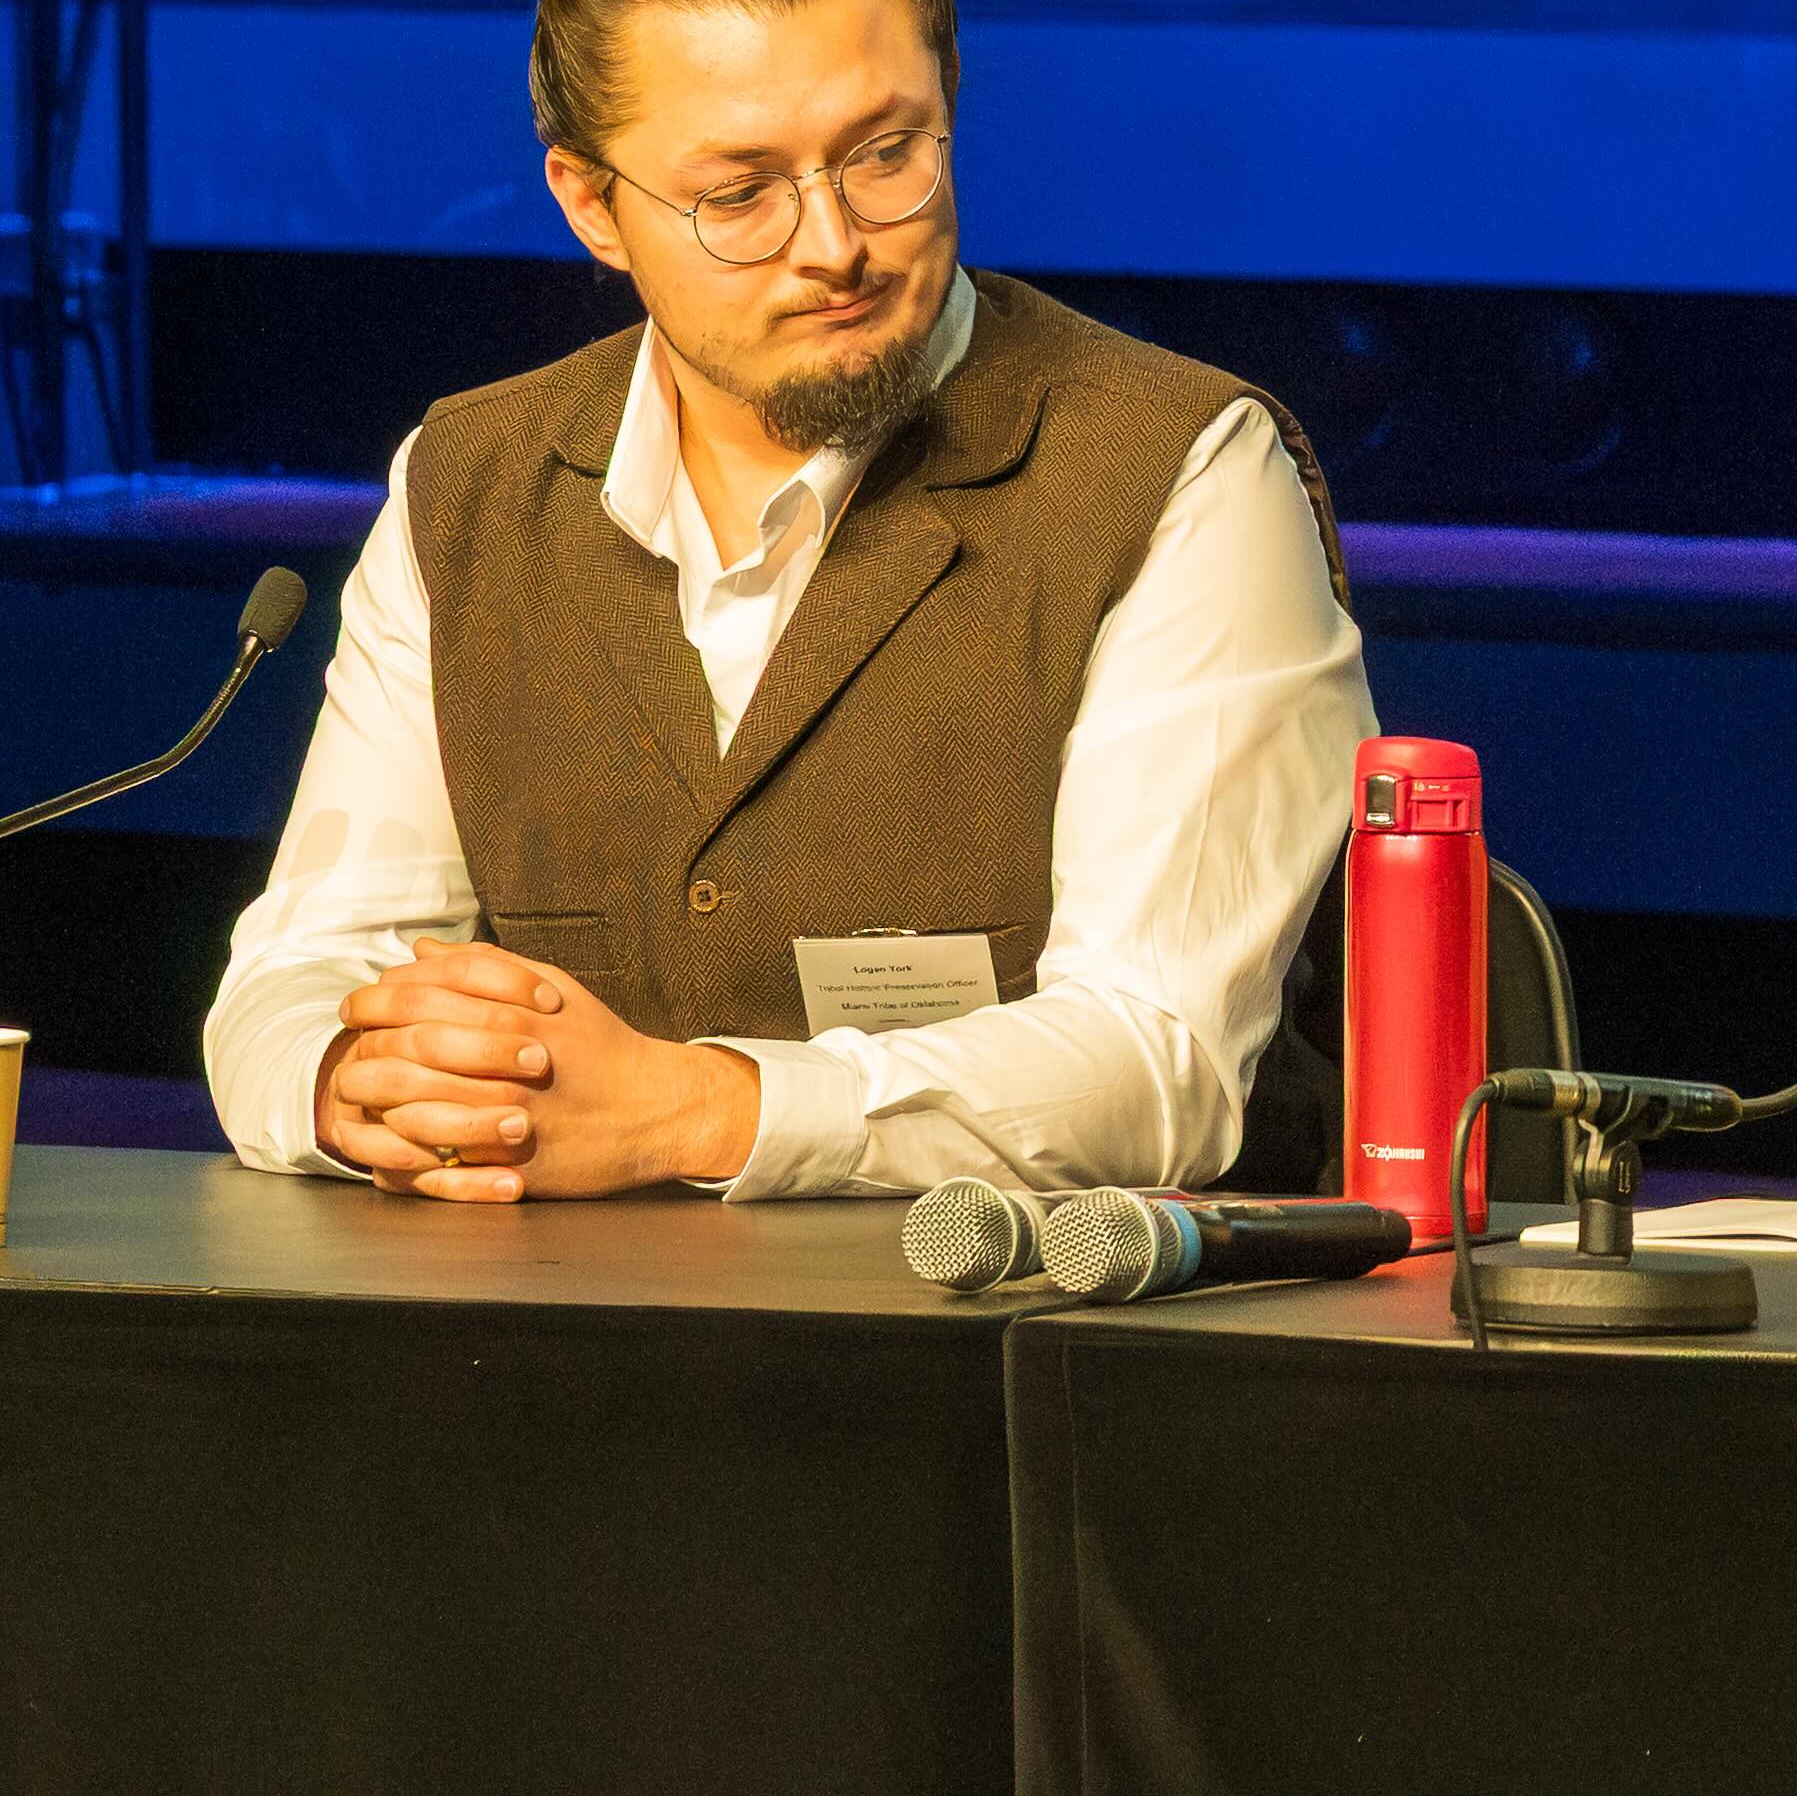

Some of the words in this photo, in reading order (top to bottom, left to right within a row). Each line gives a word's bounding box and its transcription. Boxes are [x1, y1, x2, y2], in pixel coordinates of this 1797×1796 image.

[853, 965, 886, 974] Logan
[889, 964, 912, 973] York
[884, 982, 944, 991] Preservation
[946, 979, 978, 988] Officer
[873, 1002, 897, 1010] Tribe
[910, 999, 960, 1009] Oklahoma
